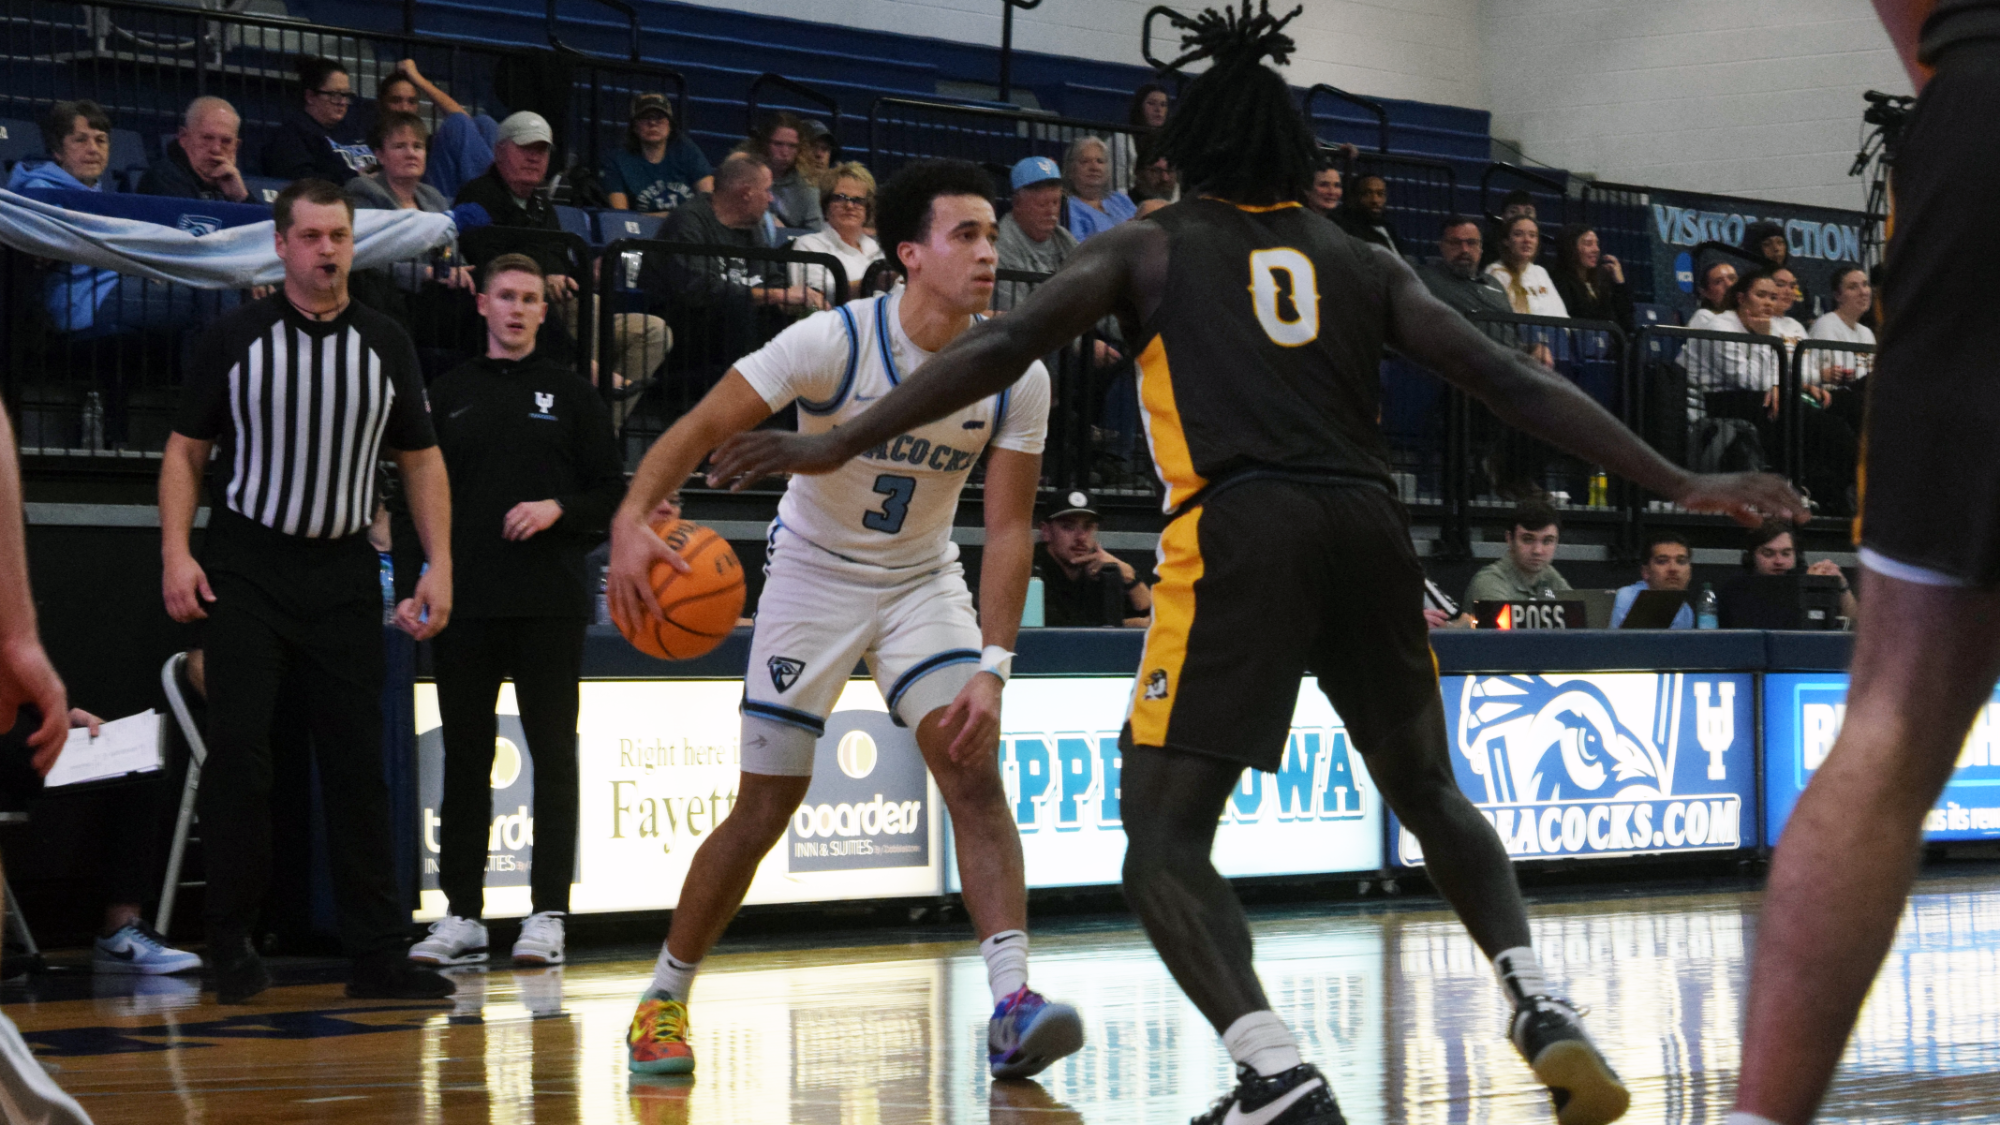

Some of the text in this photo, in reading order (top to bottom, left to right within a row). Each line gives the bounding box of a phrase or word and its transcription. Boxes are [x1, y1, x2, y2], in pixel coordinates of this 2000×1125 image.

[1652, 204, 1860, 263] VISITO CTION
[1247, 247, 1321, 347] 0
[862, 474, 917, 534] 3
[1511, 604, 1566, 630] POSS
[619, 736, 741, 775] Right here i
[1000, 726, 1366, 832] PPE OWA
[608, 780, 738, 854] Fayett
[794, 793, 921, 839] boarders
[794, 842, 819, 858] INN
[819, 843, 829, 857] &
[829, 839, 874, 857] SUITES
